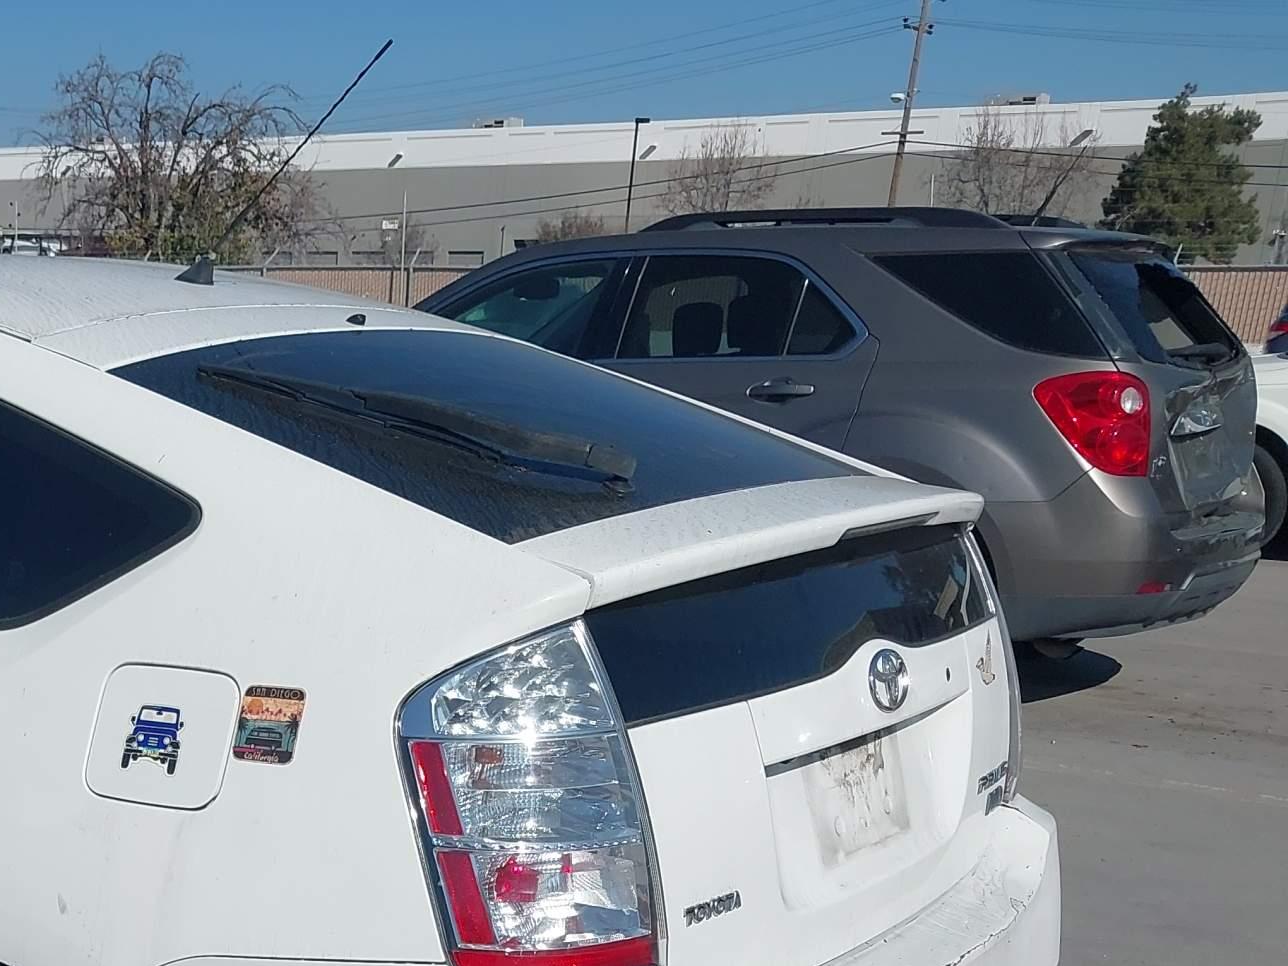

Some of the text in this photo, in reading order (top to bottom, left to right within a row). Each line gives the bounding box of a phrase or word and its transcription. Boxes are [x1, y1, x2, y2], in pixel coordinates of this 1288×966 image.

[252, 687, 301, 699] SAN DIEGO
[683, 889, 742, 928] TOYOTA
